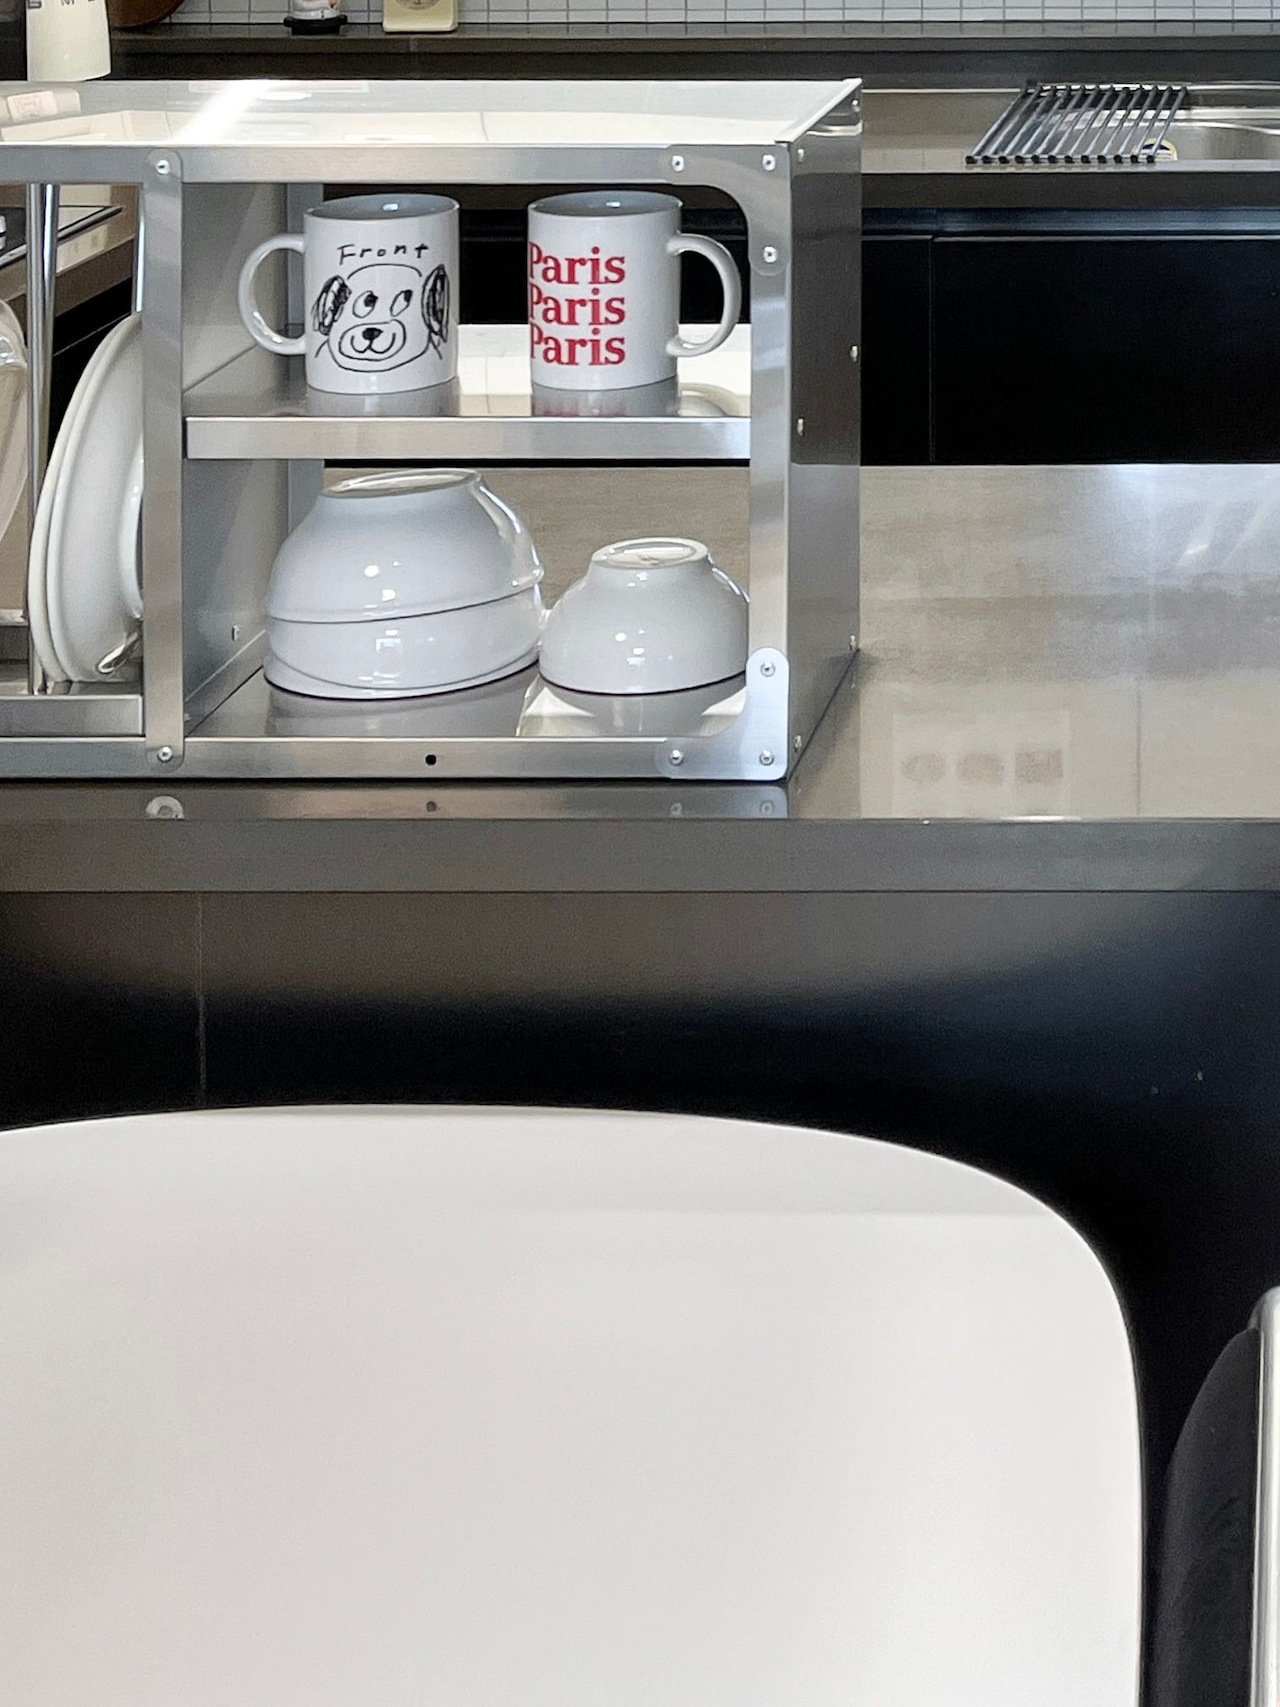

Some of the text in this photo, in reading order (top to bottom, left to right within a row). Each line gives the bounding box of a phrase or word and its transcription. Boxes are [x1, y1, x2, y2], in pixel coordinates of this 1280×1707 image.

[337, 243, 429, 265] Front
[528, 242, 626, 285] Paris
[529, 283, 626, 326] Paris
[530, 323, 626, 366] Paris
